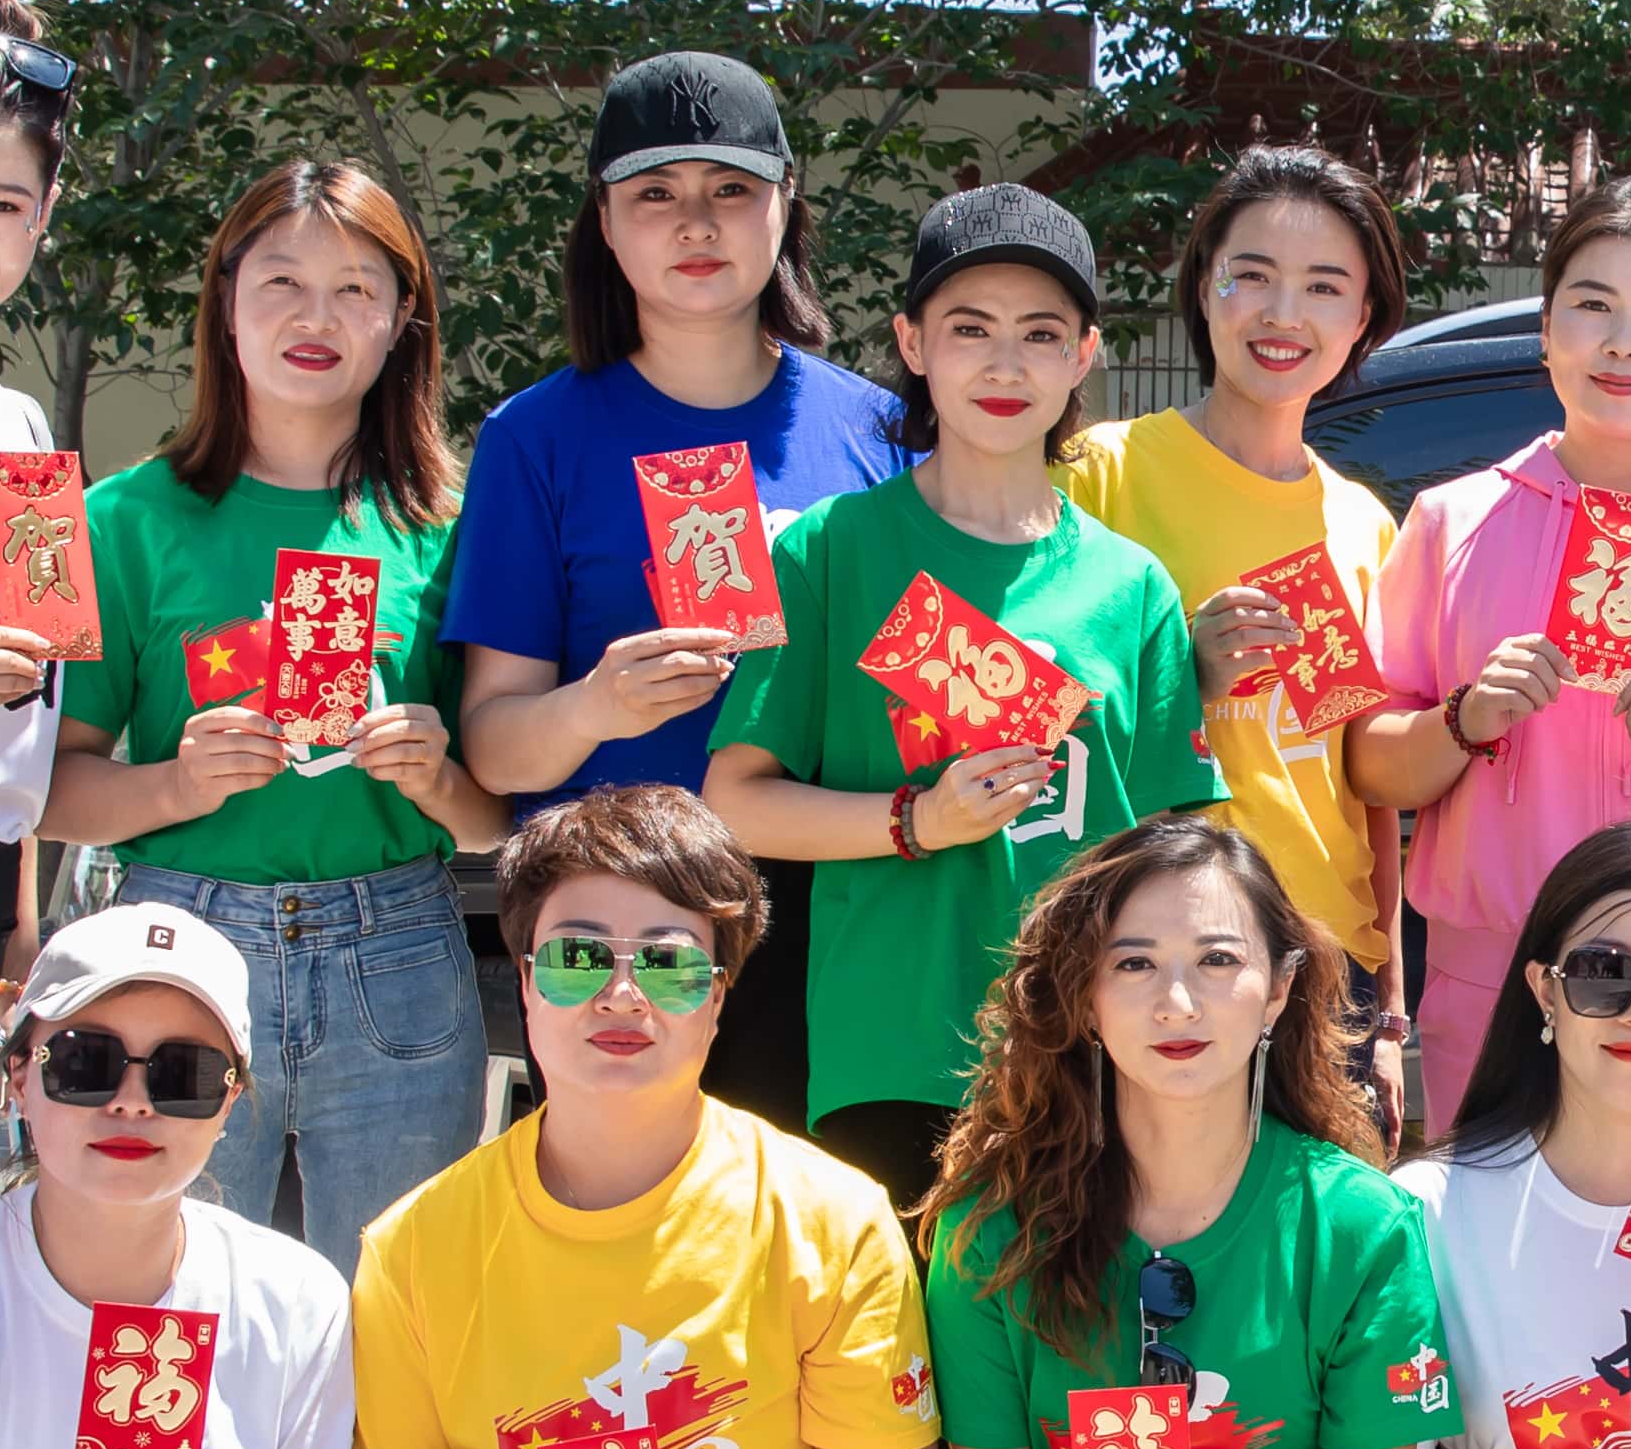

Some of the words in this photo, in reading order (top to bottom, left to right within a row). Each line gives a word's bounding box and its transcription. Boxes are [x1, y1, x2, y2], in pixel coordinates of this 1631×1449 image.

[665, 503, 754, 601] 賀
[917, 624, 1028, 727] 福
[1203, 701, 1264, 722] CHIN
[93, 1314, 201, 1435] 福
[1392, 1394, 1419, 1405] CHINA
[1410, 1342, 1449, 1413] 中国
